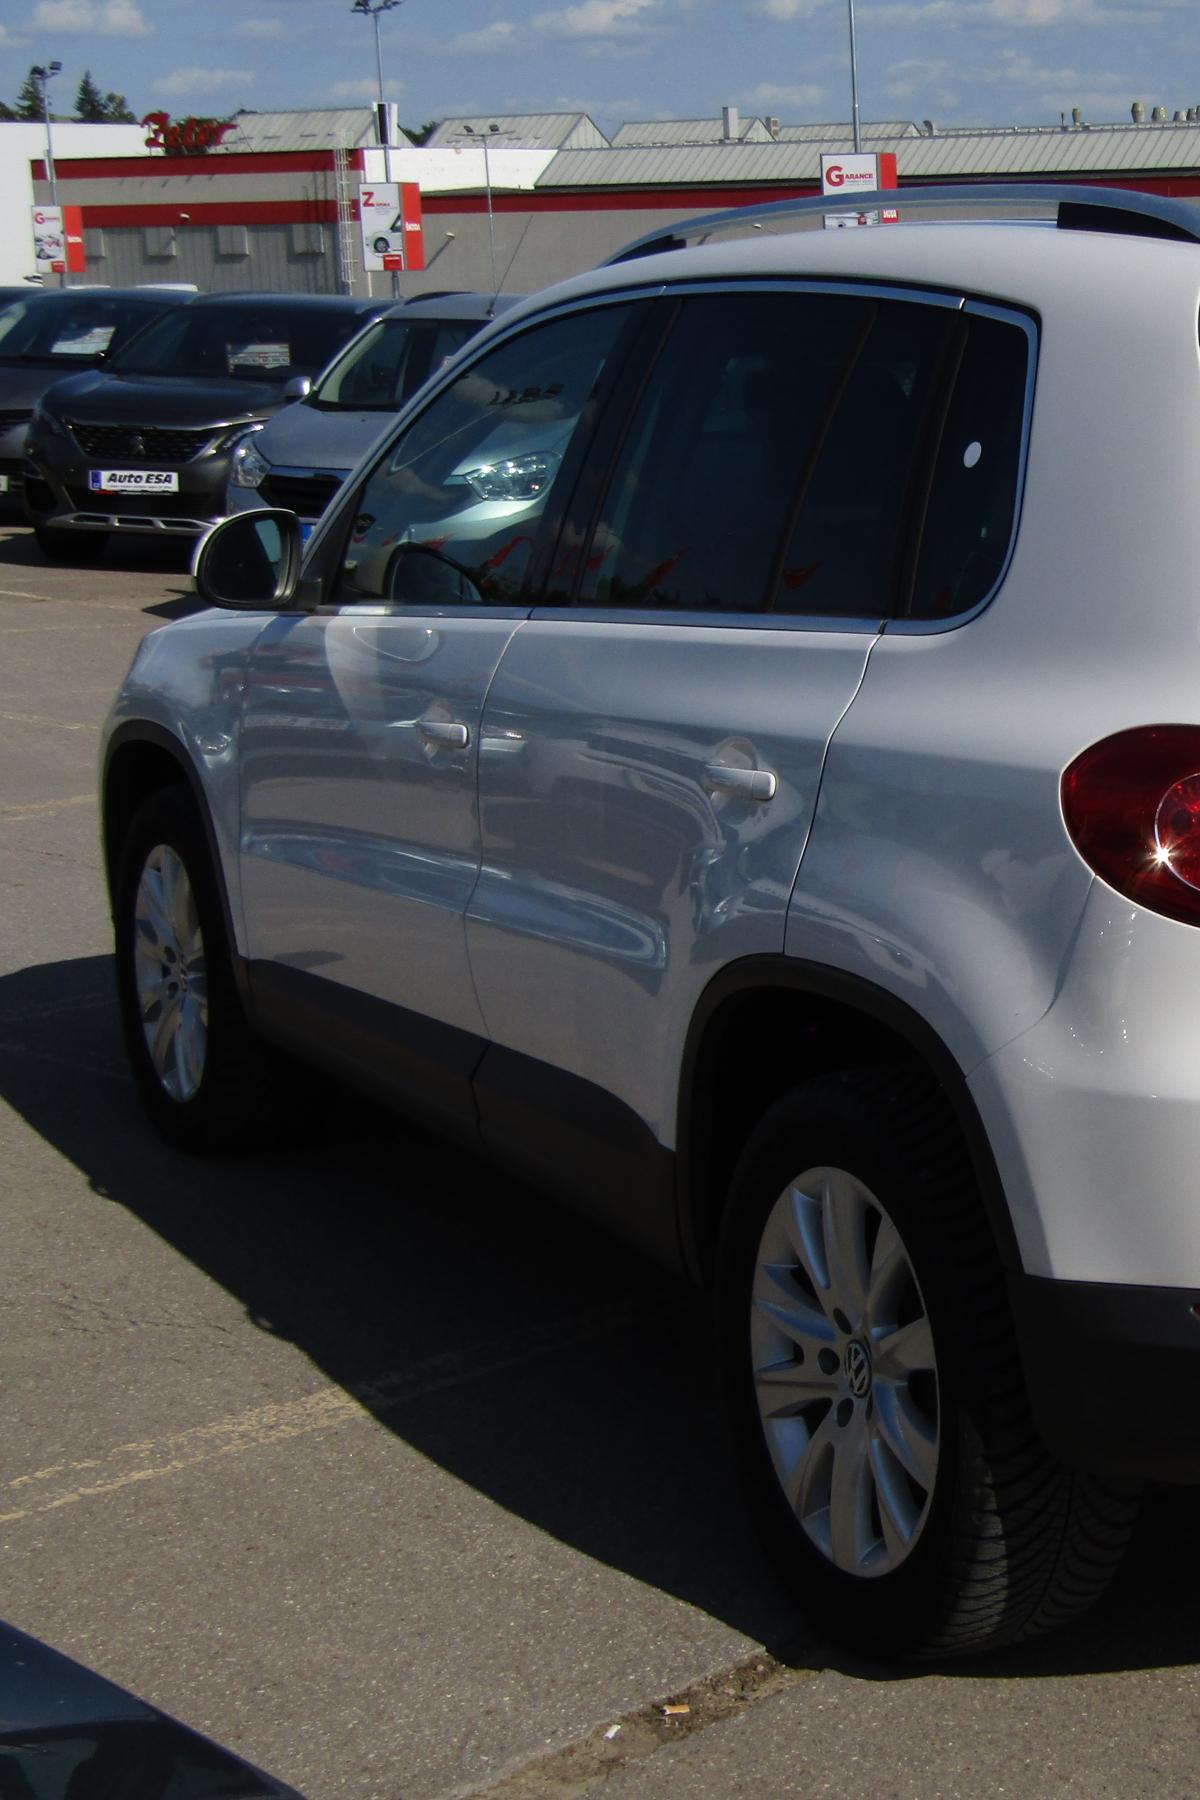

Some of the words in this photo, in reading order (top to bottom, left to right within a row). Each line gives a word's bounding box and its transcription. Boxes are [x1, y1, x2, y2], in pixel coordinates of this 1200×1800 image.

[825, 165, 873, 187] GARANCE
[107, 473, 143, 484] Auto
[145, 473, 173, 484] ESA
